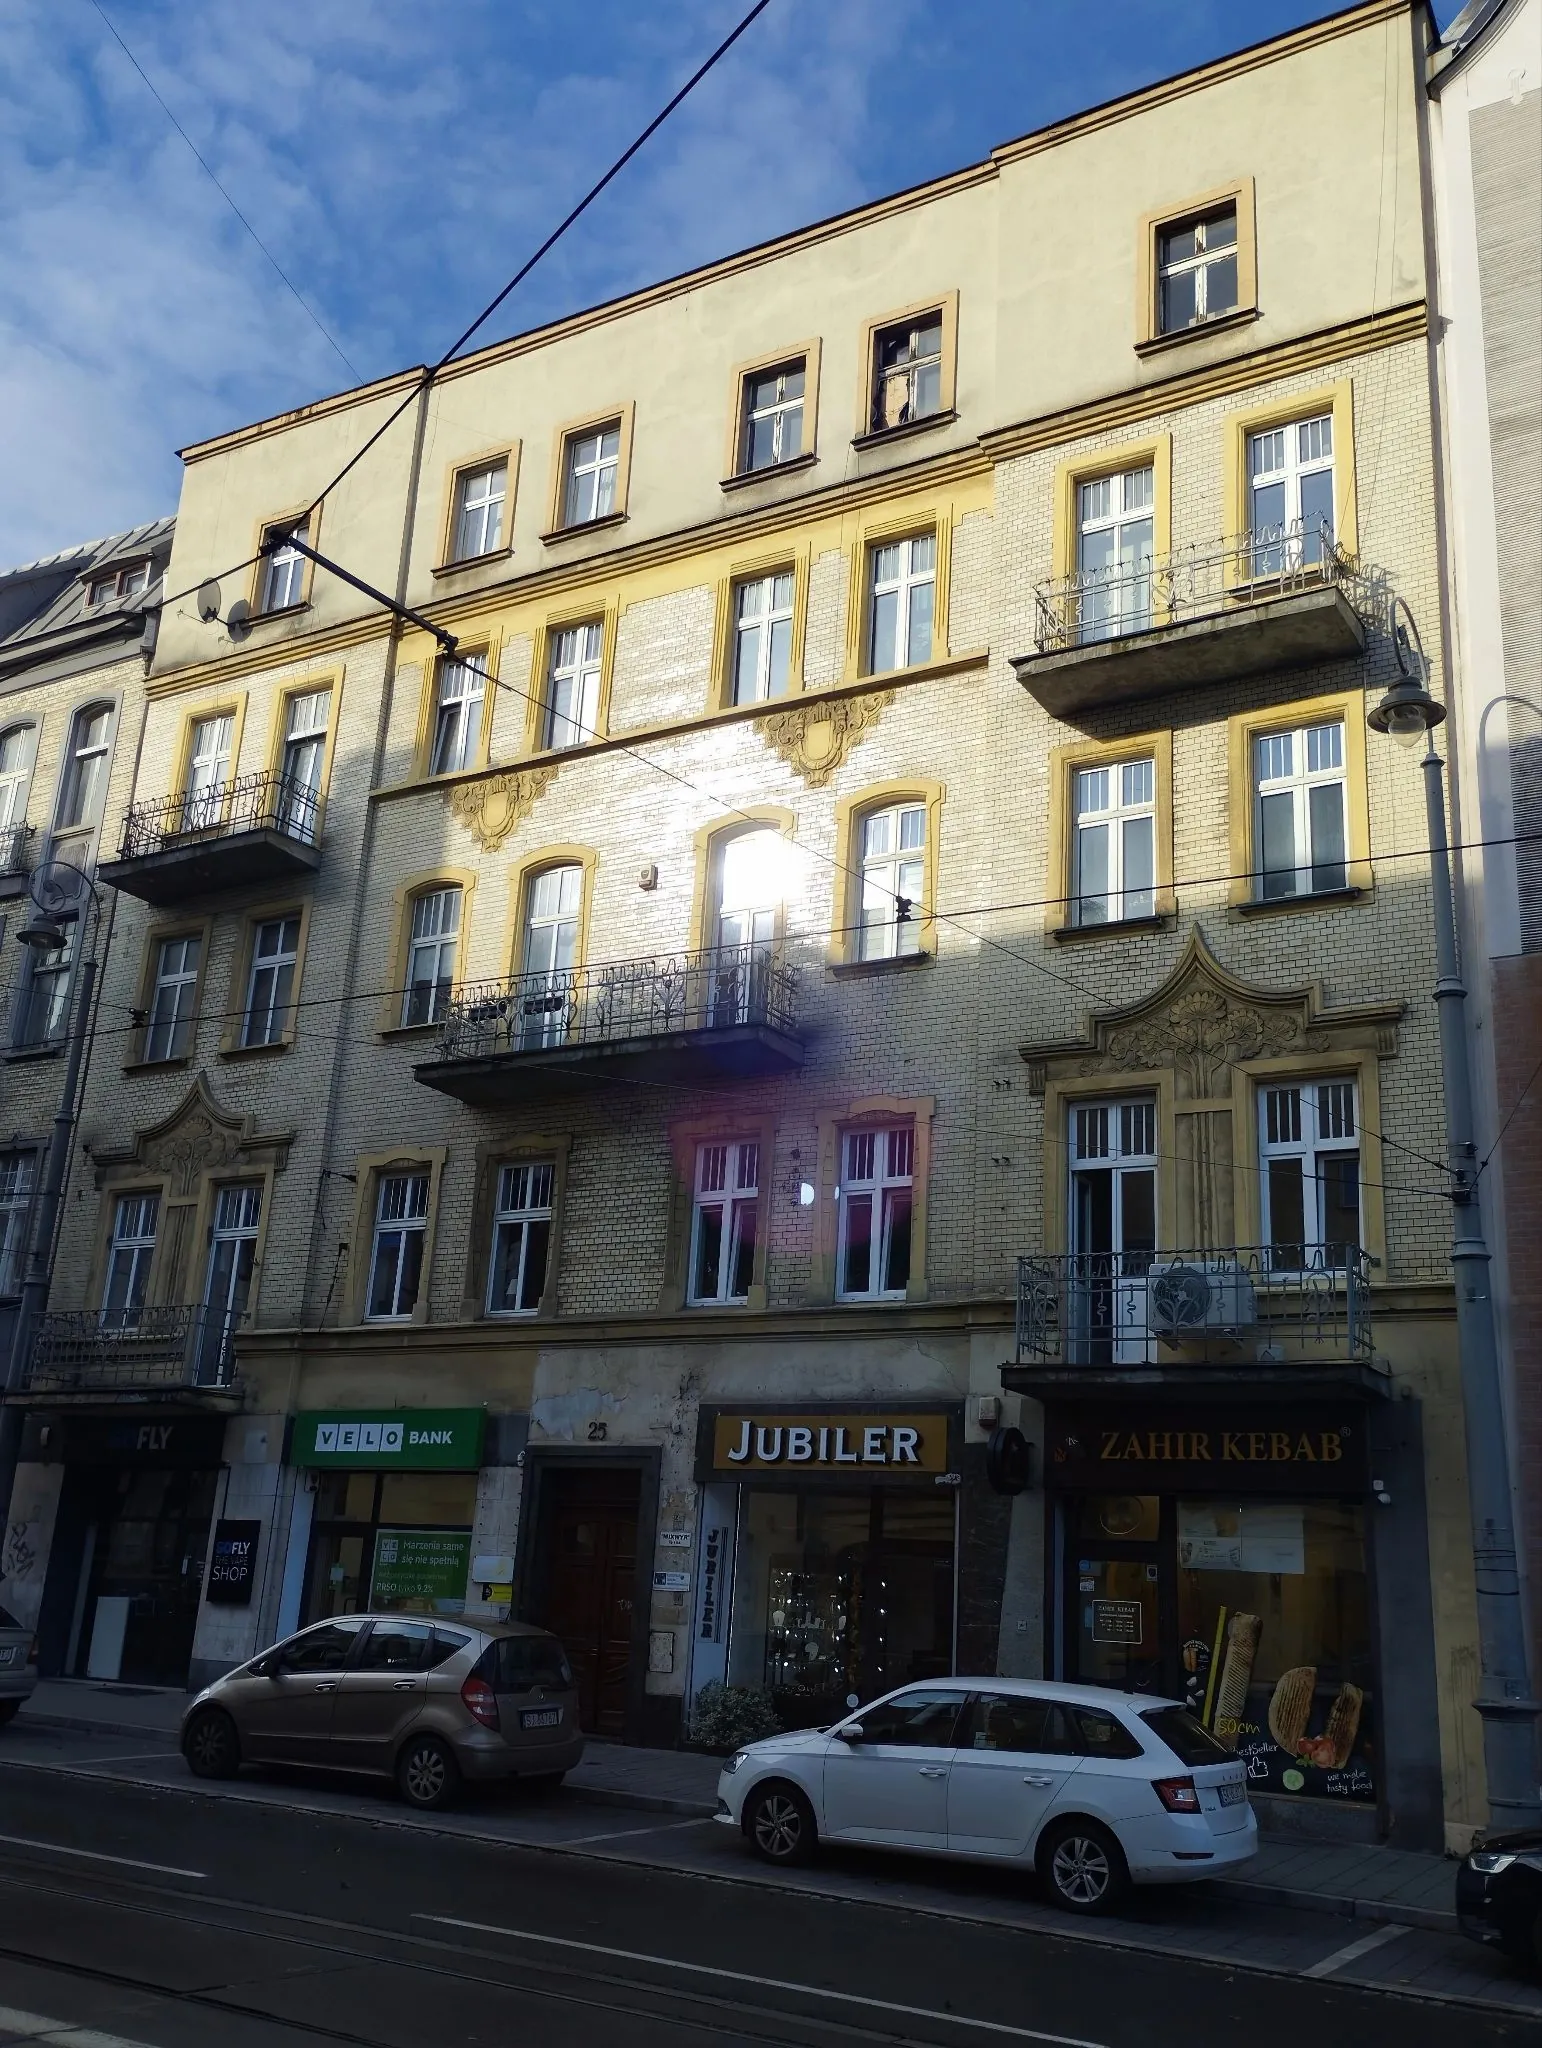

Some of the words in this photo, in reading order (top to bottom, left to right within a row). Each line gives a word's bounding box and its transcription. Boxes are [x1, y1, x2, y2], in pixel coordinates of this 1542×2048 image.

[321, 1429, 399, 1447] VELO
[408, 1430, 454, 1446] BANK
[588, 1422, 607, 1441] 25
[728, 1421, 919, 1464] JUBILER
[1099, 1432, 1212, 1460] ZAHIR
[1220, 1432, 1343, 1461] KEBAB
[403, 1540, 441, 1551] Marzenia
[442, 1543, 465, 1552] same
[415, 1555, 428, 1565] nie
[211, 1566, 249, 1581] SHOP
[701, 1529, 719, 1639] JUBILER
[1327, 1773, 1340, 1782] we
[1326, 1781, 1348, 1795] tasty
